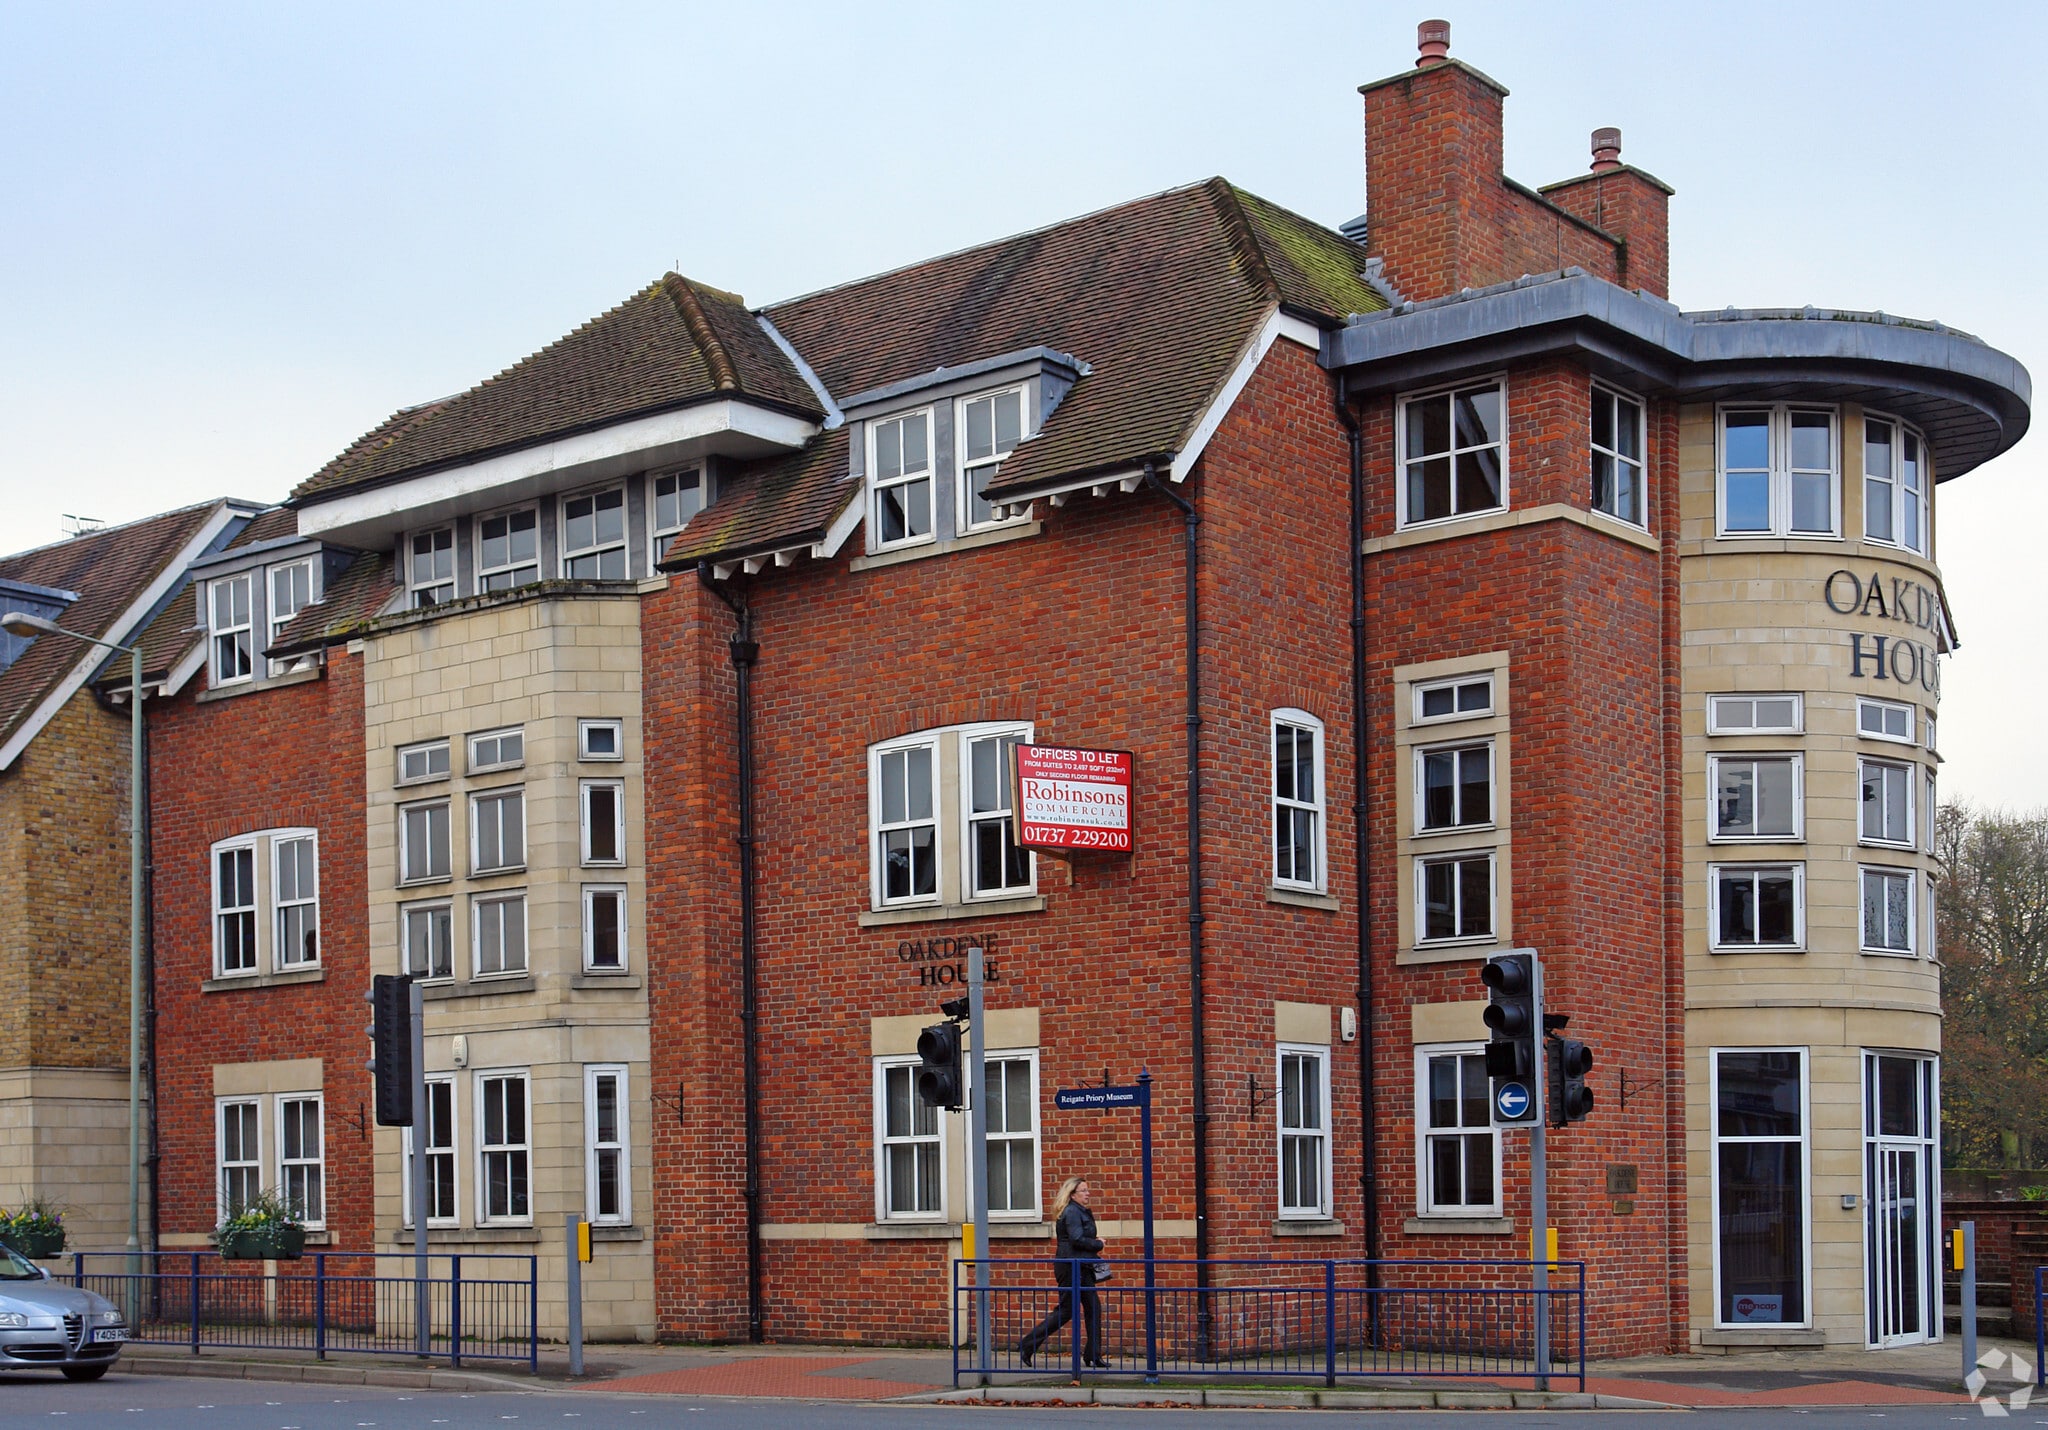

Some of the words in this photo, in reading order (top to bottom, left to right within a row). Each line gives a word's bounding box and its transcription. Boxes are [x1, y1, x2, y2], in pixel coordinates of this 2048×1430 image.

[1030, 747, 1077, 761] OFFICES
[1080, 751, 1095, 762] TO
[1099, 753, 1119, 764] LET
[1025, 780, 1125, 806] Robinsons
[1025, 802, 1126, 818] COMMERCIAL
[1026, 814, 1126, 827] www.robinsonsuk.co.uk
[1024, 826, 1066, 843] 01737
[1071, 829, 1128, 848] 229200
[898, 933, 999, 962] OAKDENE
[919, 961, 1000, 986] HOUE
[1061, 1095, 1085, 1104] Reigate
[1085, 1094, 1105, 1103] Priory
[1106, 1093, 1133, 1101] Museum
[1738, 1303, 1777, 1312] mencap
[96, 1330, 116, 1340] Y409
